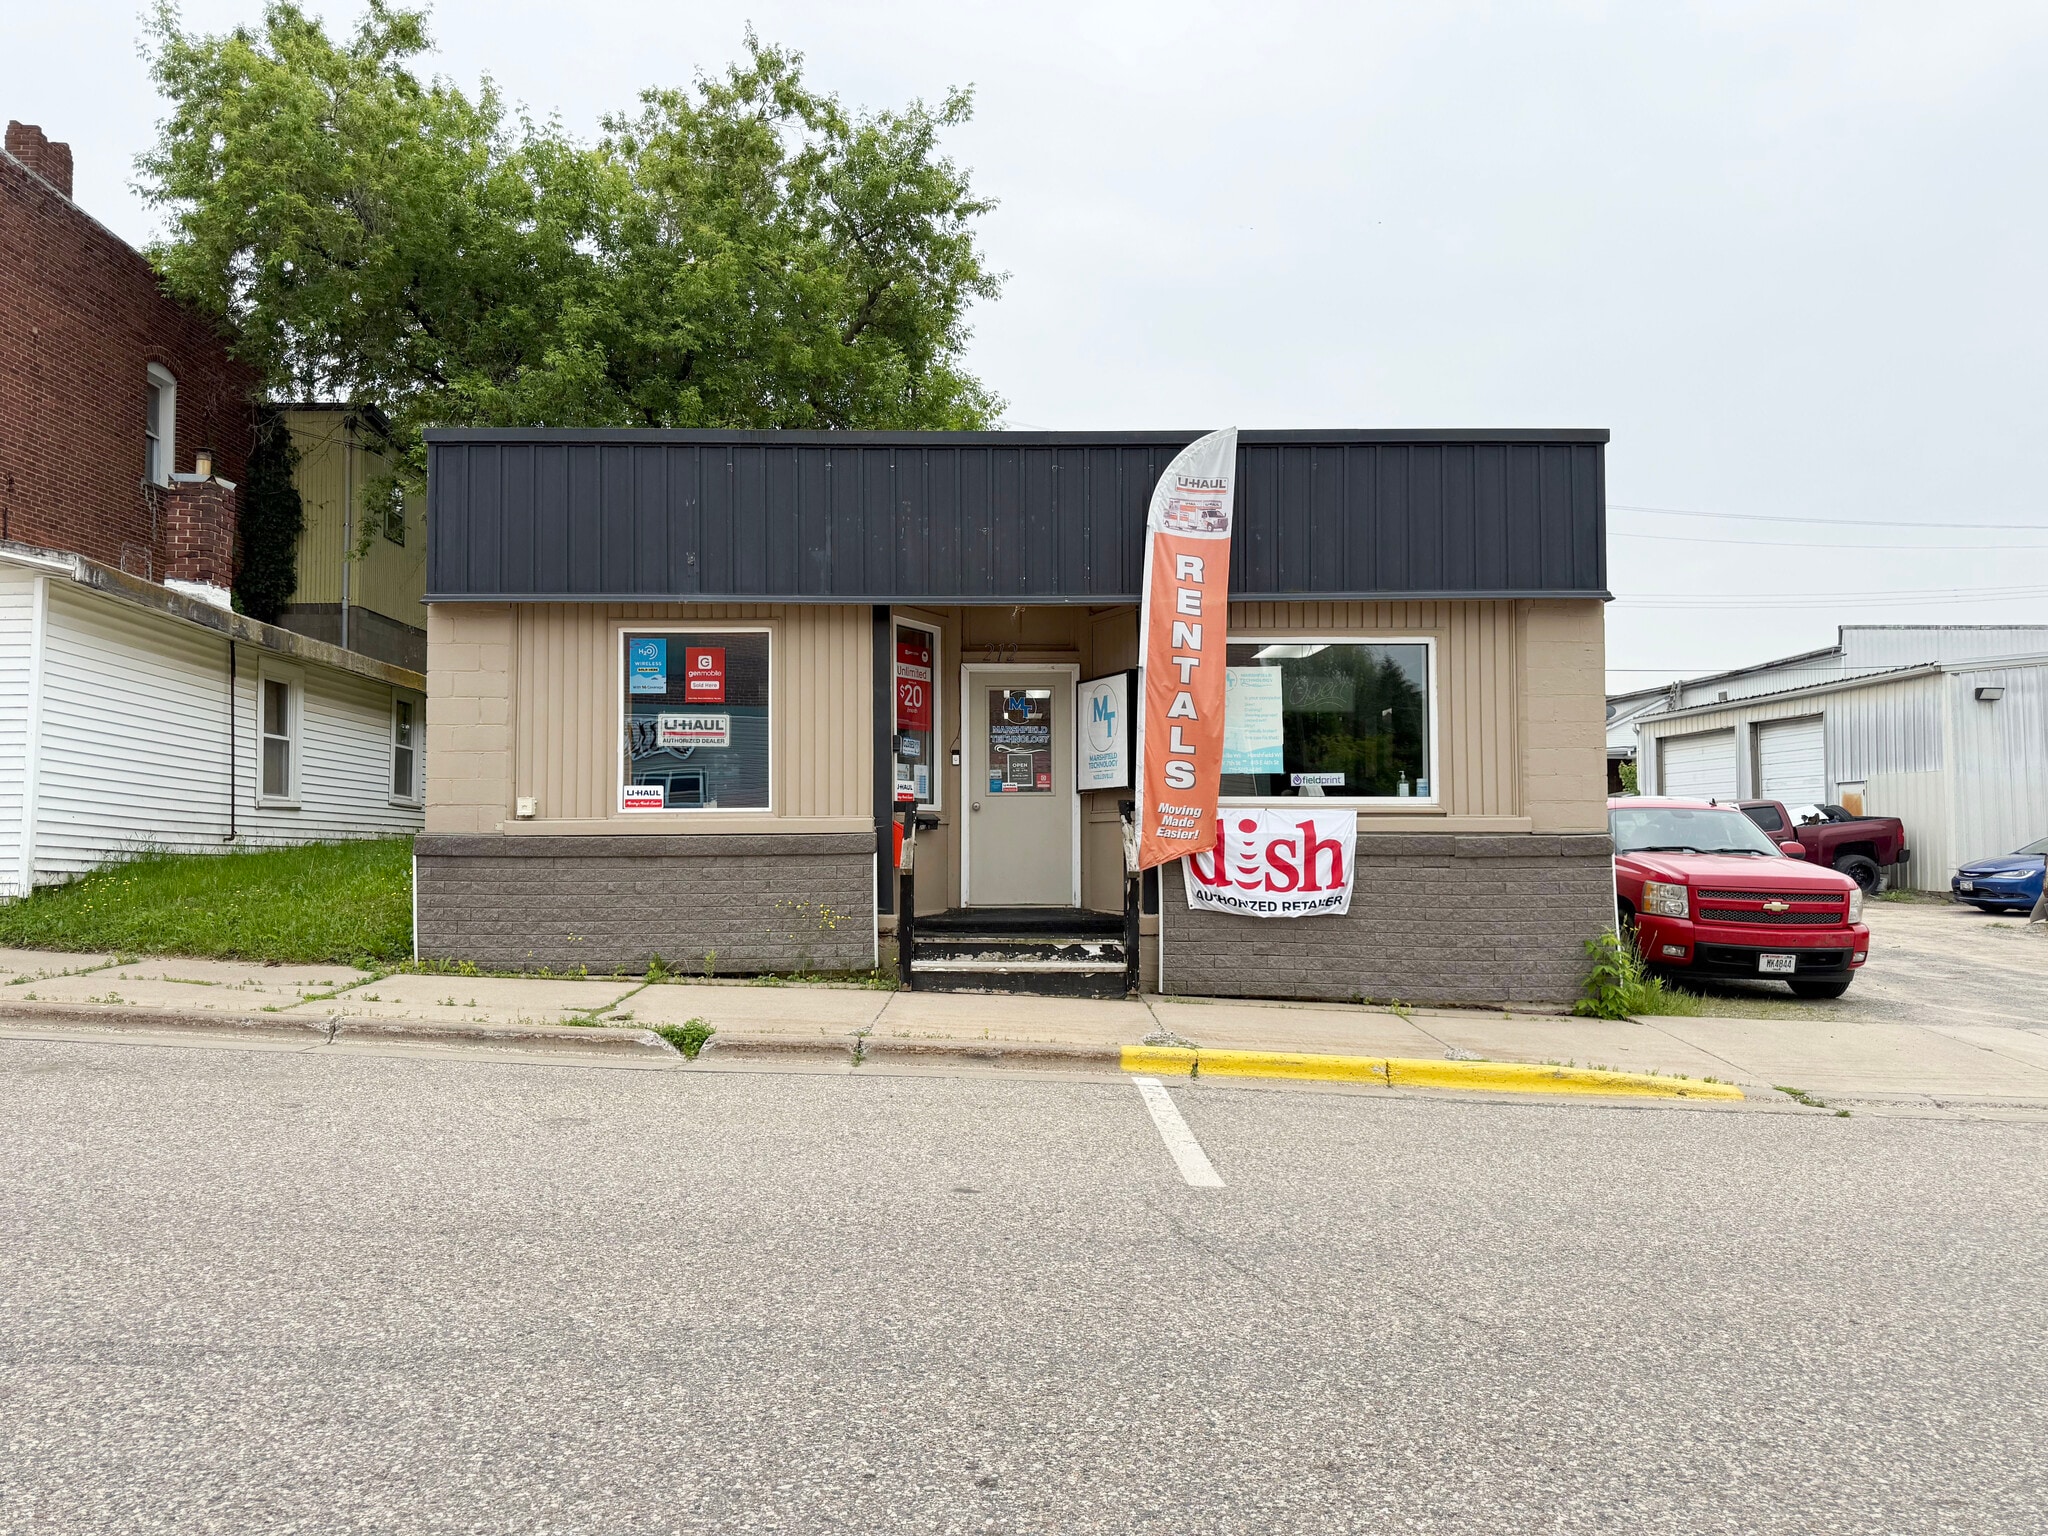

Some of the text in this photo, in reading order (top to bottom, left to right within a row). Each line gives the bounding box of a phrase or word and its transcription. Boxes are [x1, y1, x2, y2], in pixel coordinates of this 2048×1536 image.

[1177, 477, 1226, 489] U-HAUL
[982, 643, 1018, 662] 212
[897, 665, 927, 679] Unlimited
[1164, 553, 1205, 790] RENTALS
[900, 684, 922, 708] $20
[1093, 695, 1116, 738] MT
[664, 719, 724, 731] U-HAUL
[992, 725, 1048, 734] MARSHFIELD
[991, 735, 1050, 744] TECHNOLOGY
[1089, 752, 1118, 762] MARSHFIELD
[1088, 760, 1118, 769] TECHNOLOGY
[1302, 775, 1342, 785] fieldprint
[1158, 803, 1202, 819] Moving
[1162, 815, 1195, 829] Made
[1156, 827, 1200, 841] Easier!
[1190, 818, 1346, 892] dish
